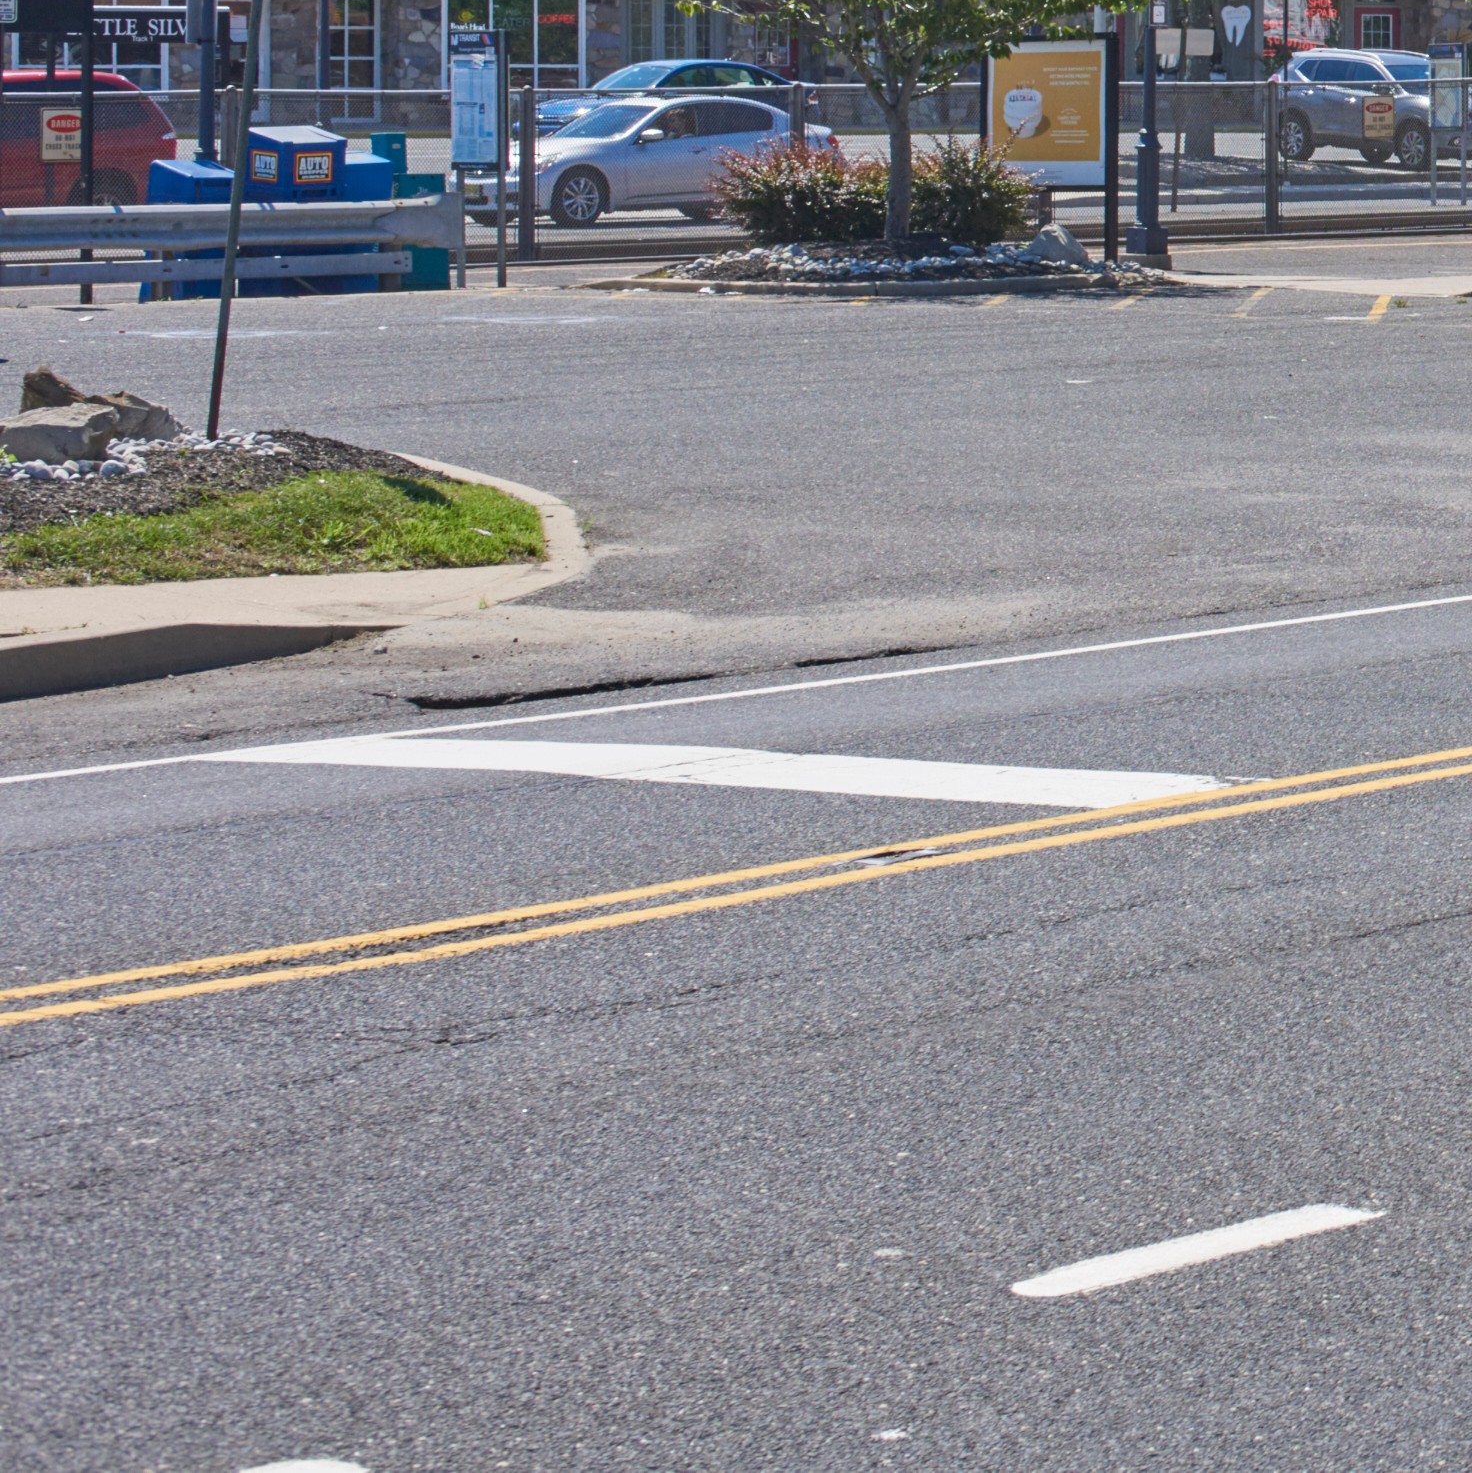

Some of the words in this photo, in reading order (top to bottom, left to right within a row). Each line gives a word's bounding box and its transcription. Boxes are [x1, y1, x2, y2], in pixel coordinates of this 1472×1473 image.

[538, 13, 576, 24] COFFEE
[1304, 8, 1338, 19] REPAIR
[148, 18, 188, 36] SILV
[50, 119, 81, 128] DANGER
[255, 154, 276, 170] AUTO
[300, 156, 329, 170] AUTO
